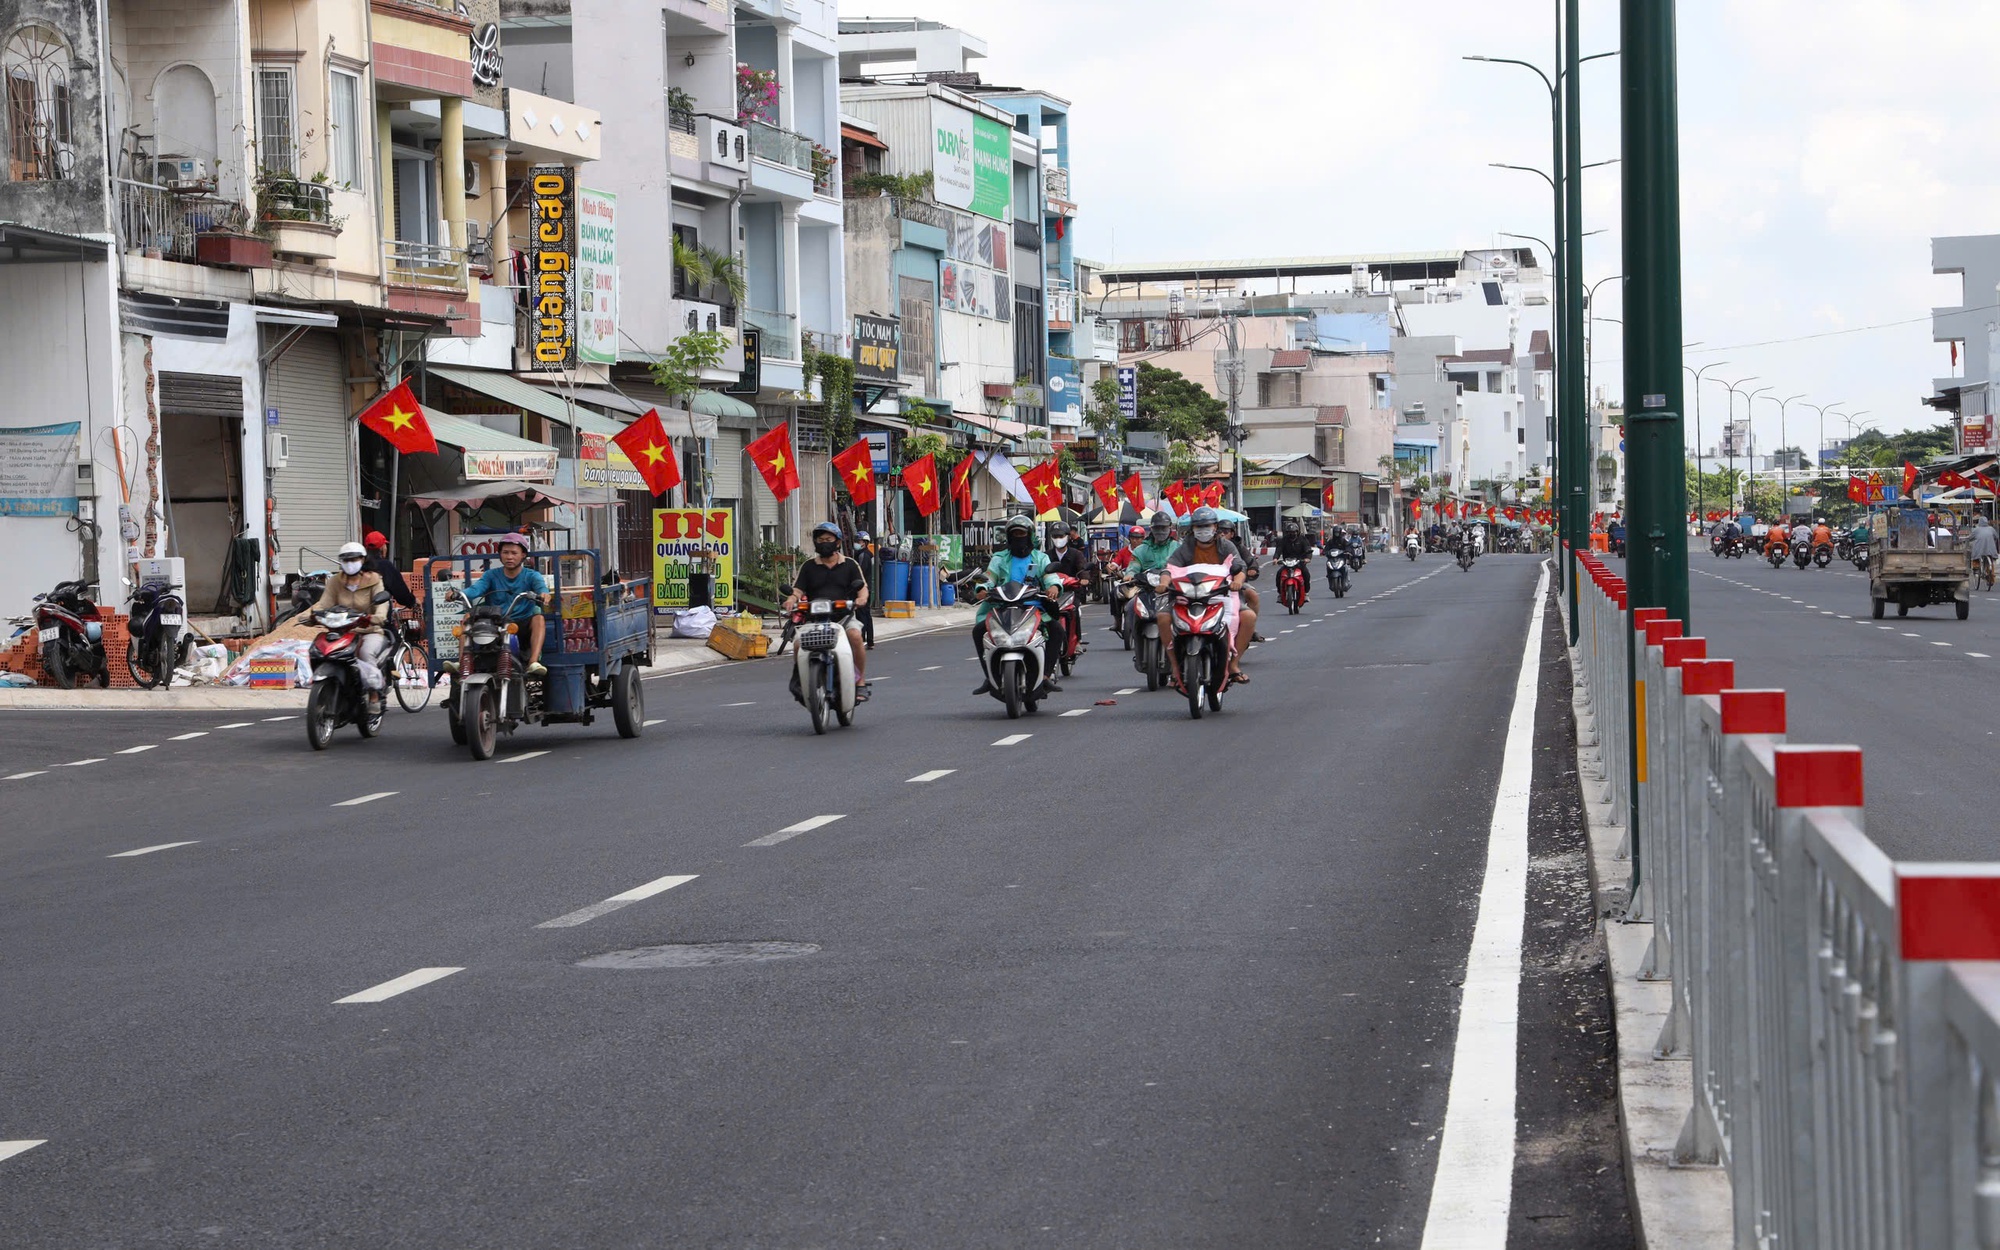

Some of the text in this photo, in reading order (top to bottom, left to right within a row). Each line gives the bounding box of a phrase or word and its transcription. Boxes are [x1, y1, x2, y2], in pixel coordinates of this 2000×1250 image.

[581, 221, 596, 240] BÚN
[581, 245, 597, 263] NHÀ
[861, 319, 892, 341] TÓC NAM
[658, 512, 729, 539] IN
[657, 539, 700, 557] QUẢNG
[657, 579, 685, 599] BẢNG
